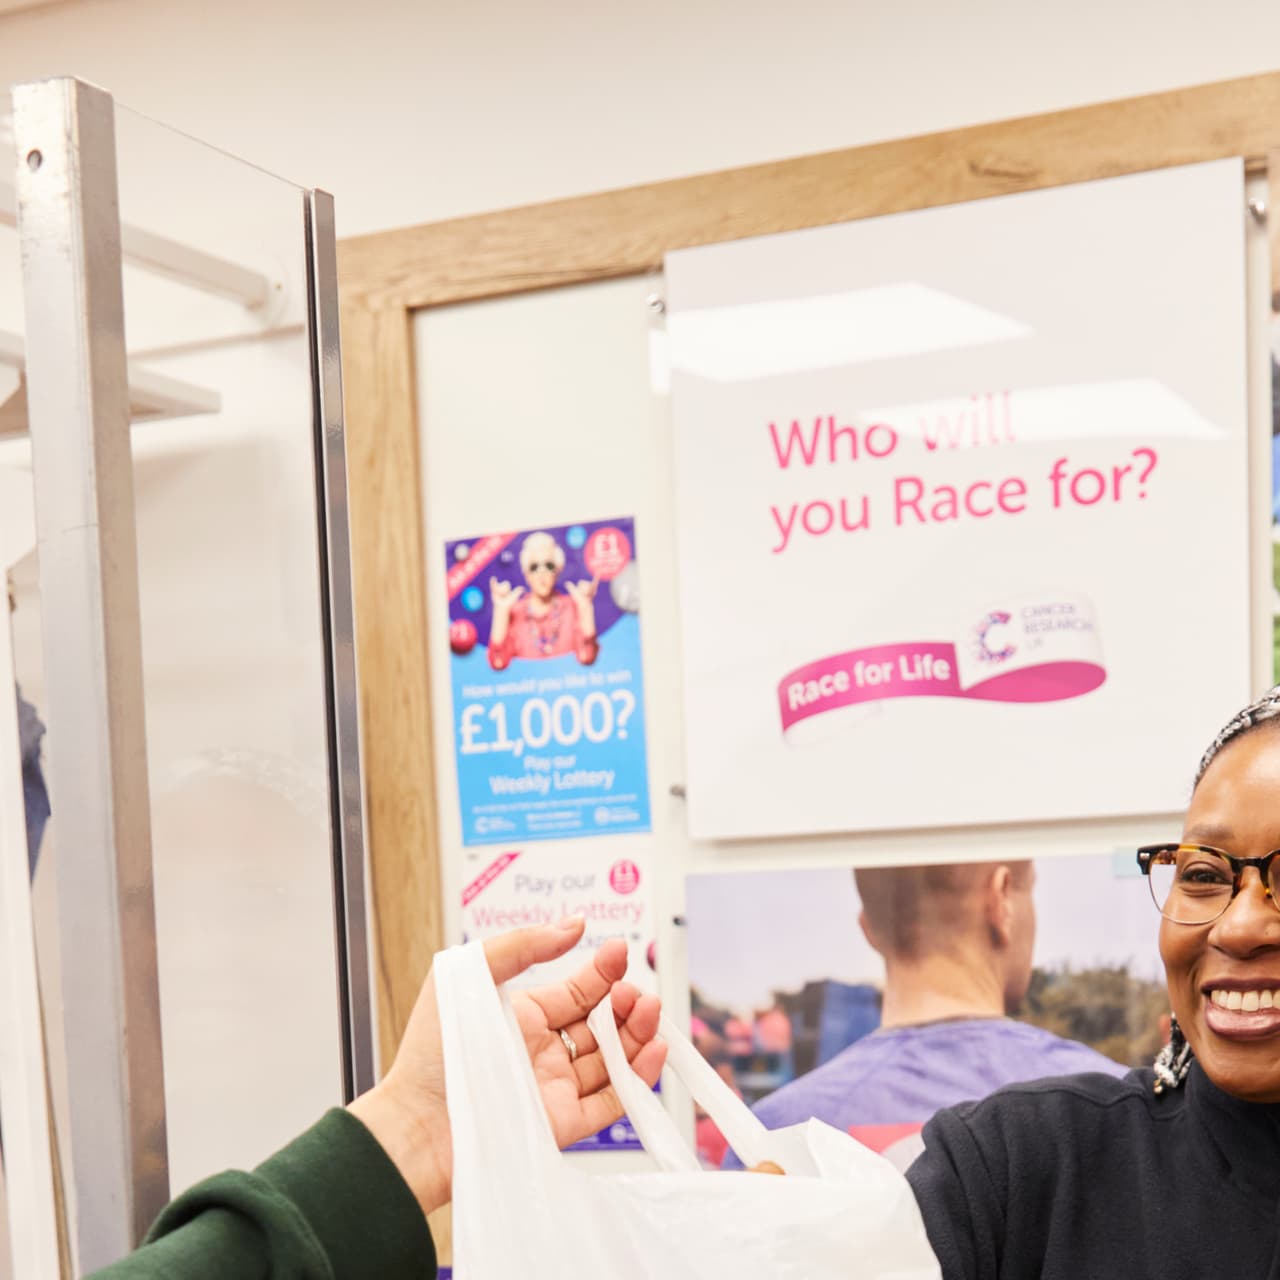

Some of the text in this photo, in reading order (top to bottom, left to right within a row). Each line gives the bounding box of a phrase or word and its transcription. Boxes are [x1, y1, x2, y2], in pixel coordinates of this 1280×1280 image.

[769, 389, 1018, 470] Who will
[770, 446, 1160, 555] you Race for?
[787, 653, 953, 712] Race for Life
[460, 688, 637, 758] £1,000?
[488, 768, 616, 797] Weekly Lottery
[523, 754, 577, 773] Play our
[514, 873, 555, 895] Play
[561, 873, 596, 890] our
[471, 903, 554, 929] Weekly
